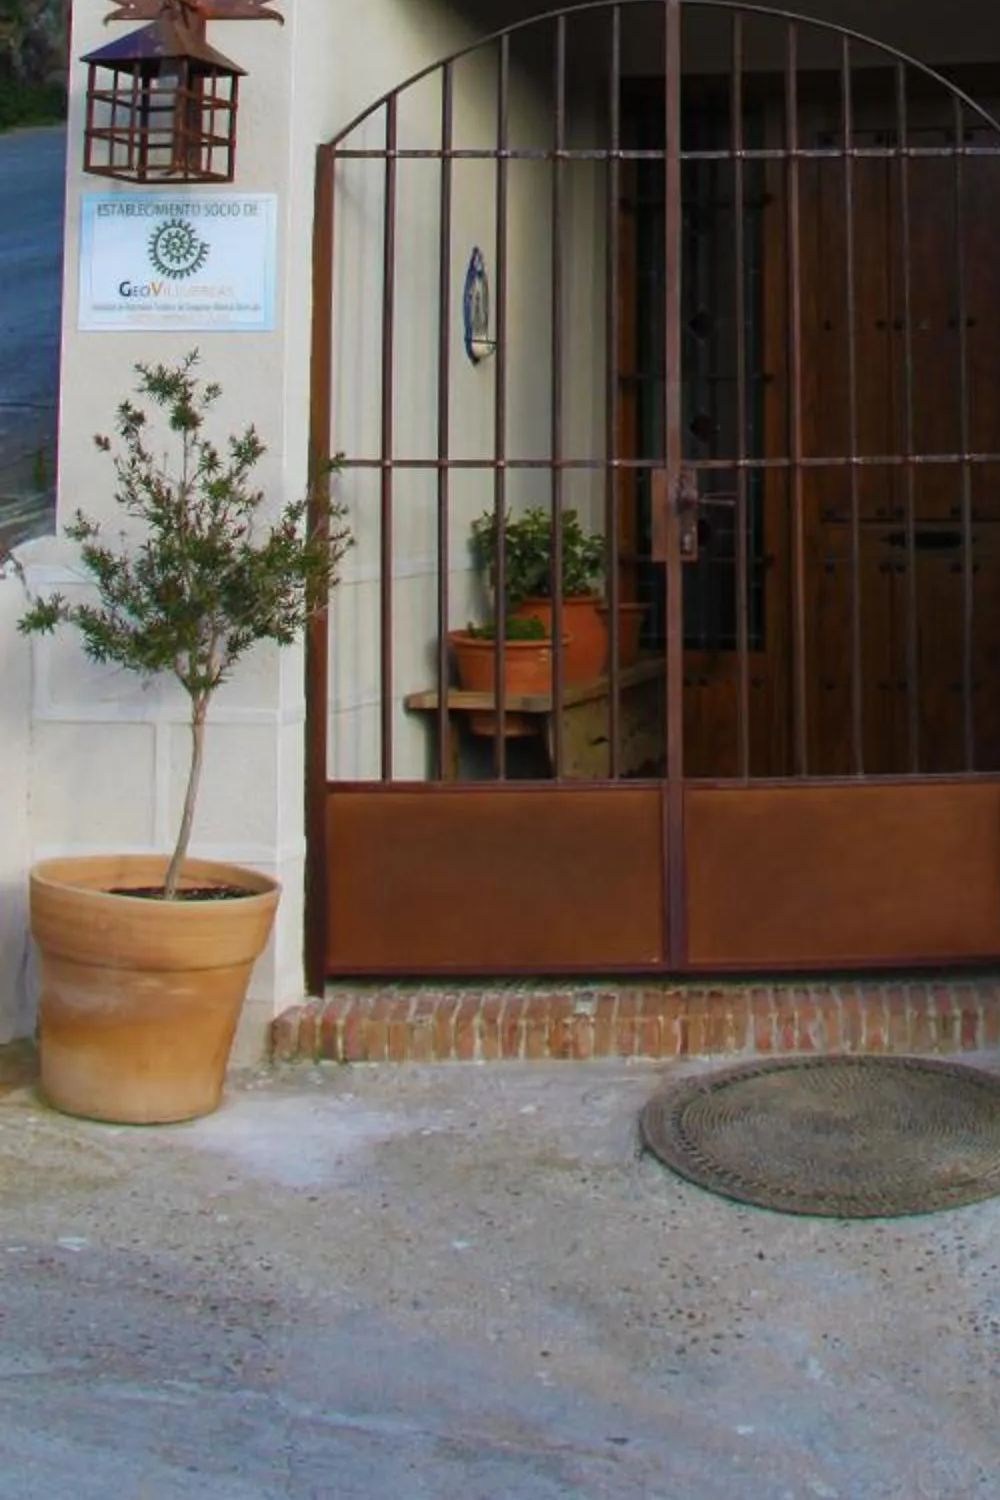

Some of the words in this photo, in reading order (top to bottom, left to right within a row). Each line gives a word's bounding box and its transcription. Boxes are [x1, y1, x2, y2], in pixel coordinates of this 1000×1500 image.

[97, 203, 201, 217] ESTABLECIMIENTO
[204, 203, 240, 217] SOCIO
[243, 203, 258, 216] DE
